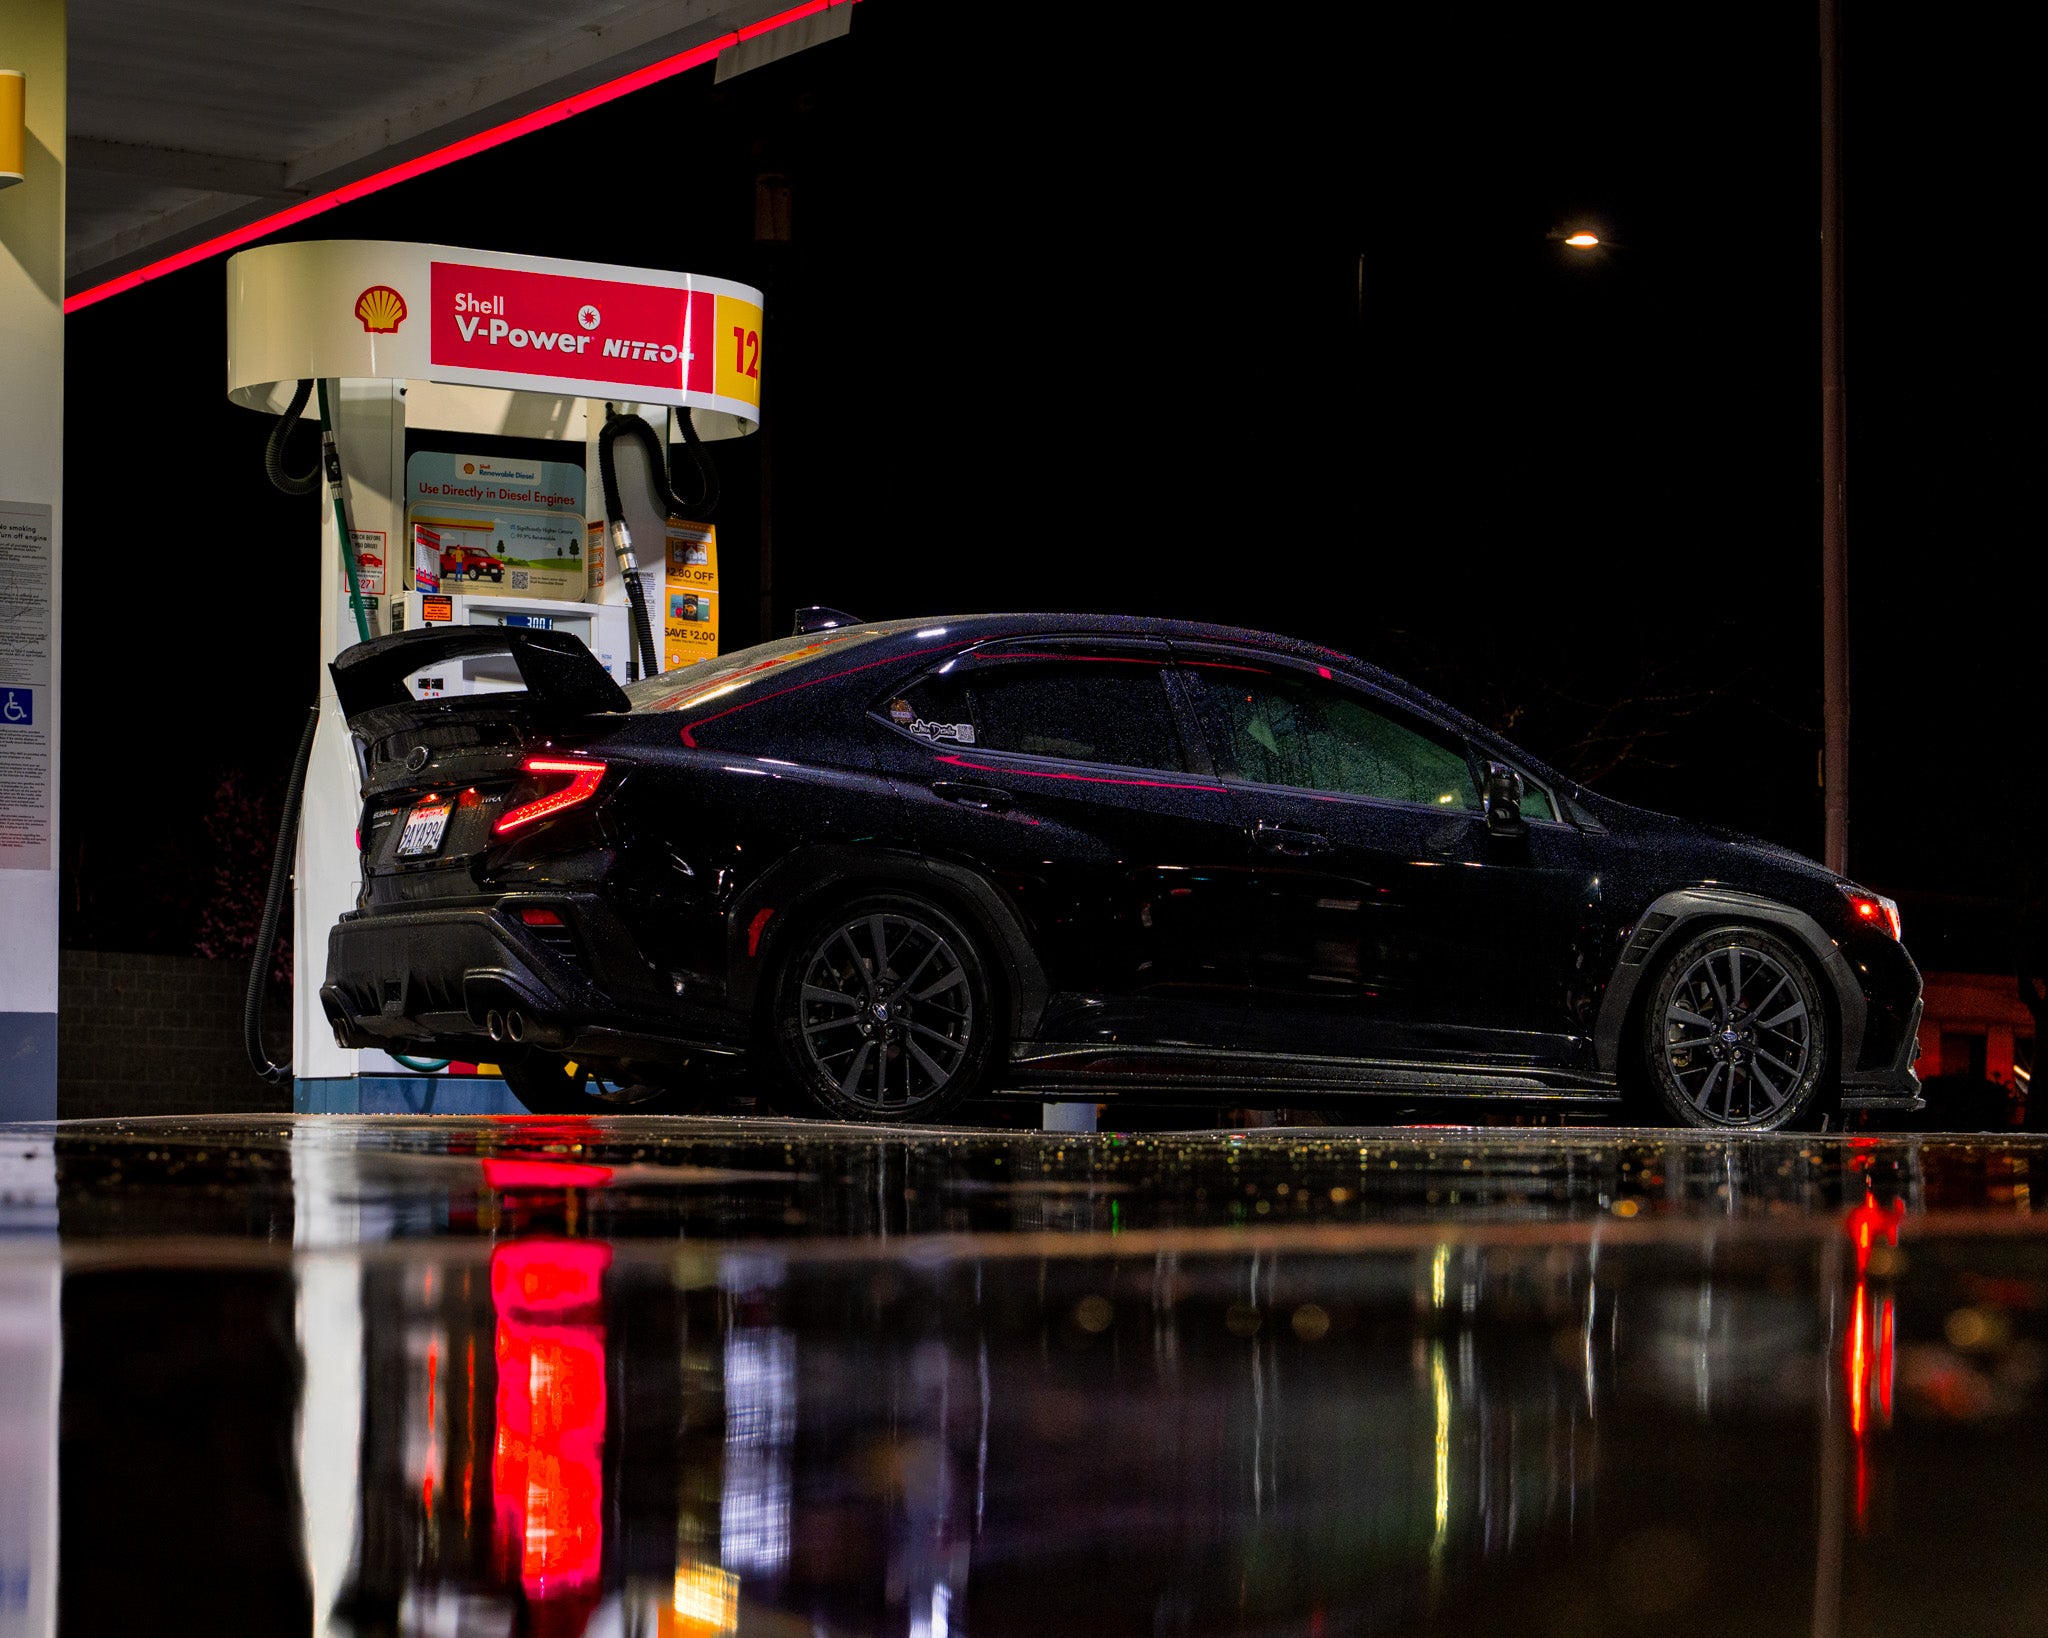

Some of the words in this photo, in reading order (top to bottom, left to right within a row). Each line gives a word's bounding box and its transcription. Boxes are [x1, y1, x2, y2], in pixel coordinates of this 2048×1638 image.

[455, 292, 504, 316] Shell
[454, 314, 591, 355] V-Power
[733, 326, 759, 379] 12
[479, 469, 514, 479] Renewable
[515, 471, 535, 480] Diesel
[419, 482, 439, 494] Use
[442, 484, 483, 500] Directly
[486, 487, 496, 499] in
[499, 489, 531, 502] Diesel
[534, 492, 575, 507] Engines
[9, 525, 37, 534] smoking
[357, 578, 375, 590] 271
[694, 571, 714, 582] OFF
[665, 627, 688, 639] SAVE
[690, 630, 716, 642] $2.00
[399, 821, 444, 849] 9AYA994
